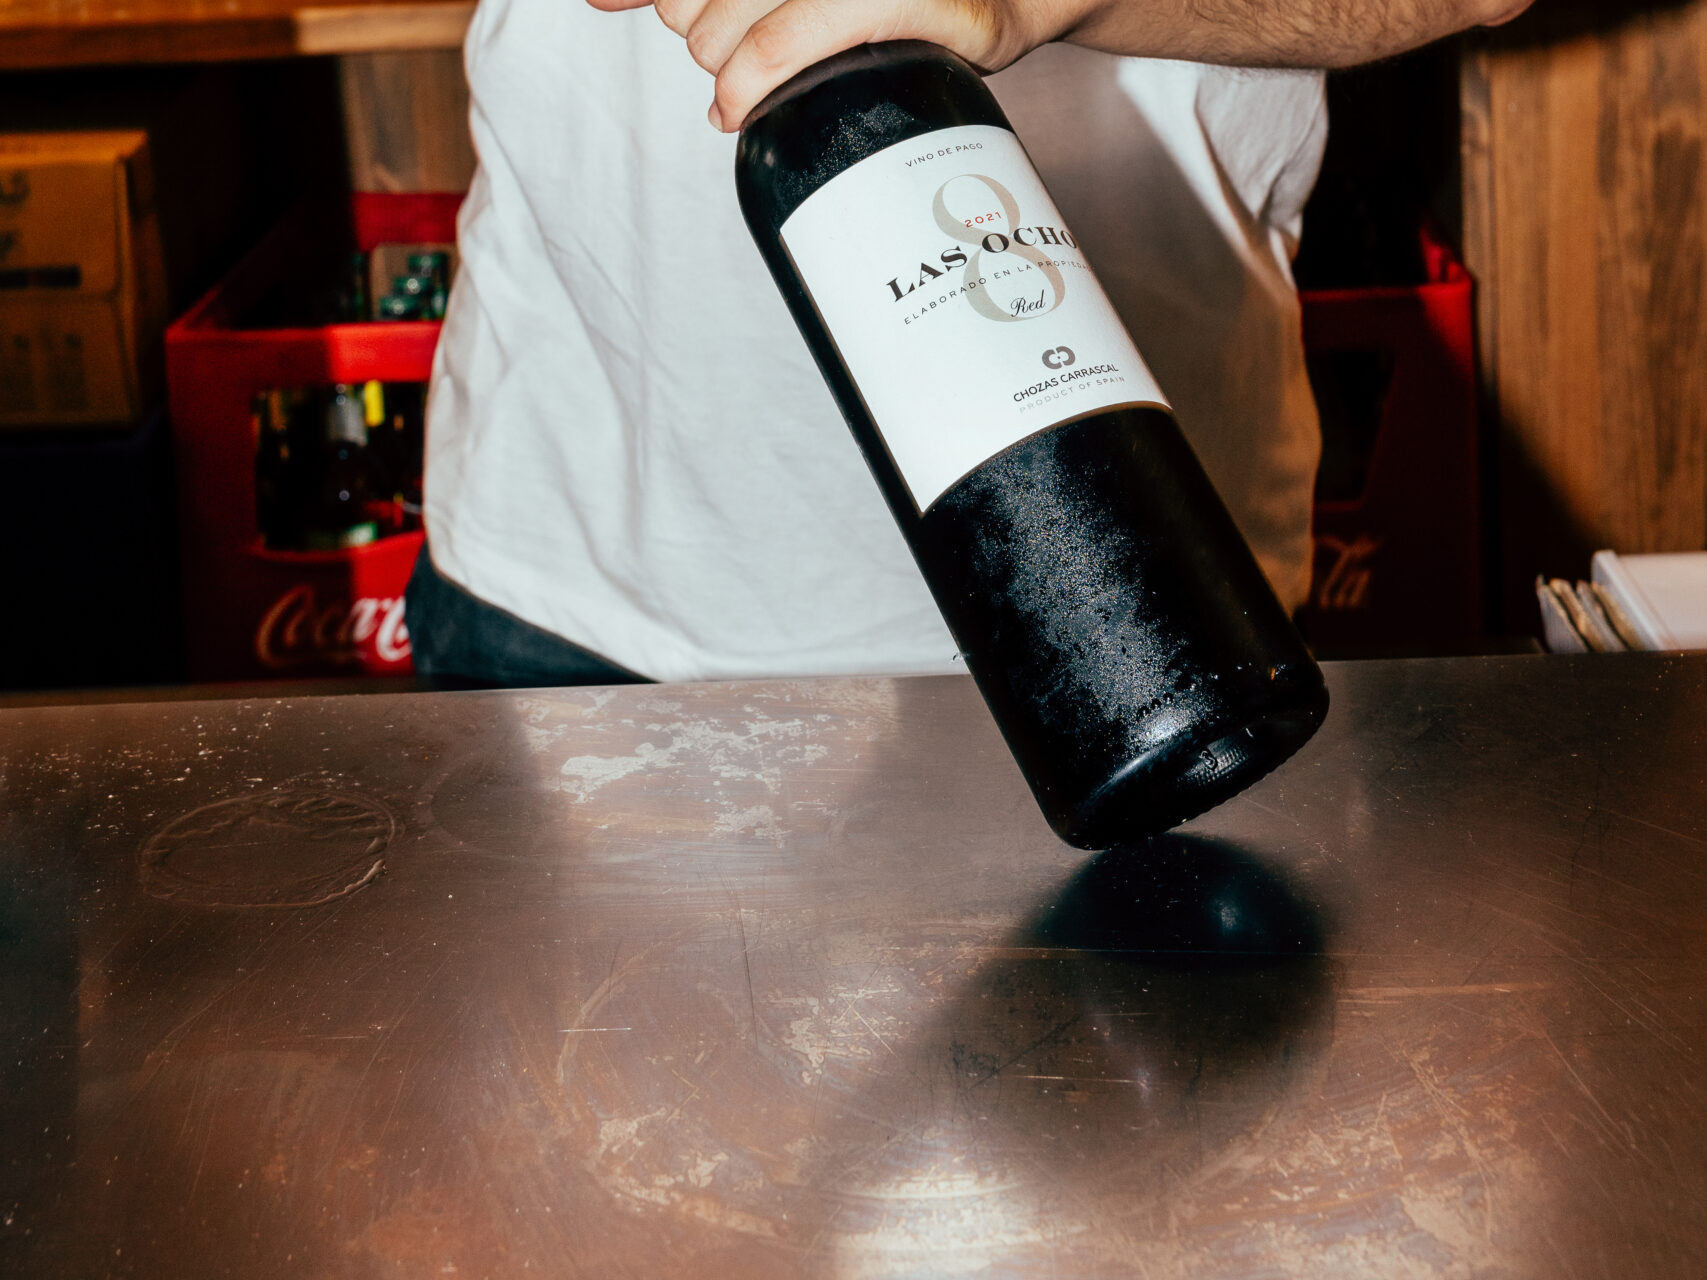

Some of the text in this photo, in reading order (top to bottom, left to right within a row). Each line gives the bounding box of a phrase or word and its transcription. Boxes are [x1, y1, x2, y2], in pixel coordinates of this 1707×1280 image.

[905, 142, 983, 168] VINO DE PAGO
[964, 211, 1002, 228] 2021
[886, 226, 1078, 303] LAS OCHO
[904, 278, 987, 325] ELABORADO
[994, 269, 1011, 280] EN
[1017, 263, 1033, 273] LA
[1010, 289, 1046, 318] Red
[1013, 363, 1119, 403] CHOZAS CARRASCAL
[1020, 376, 1126, 414] PRODUCT OF SPAIN
